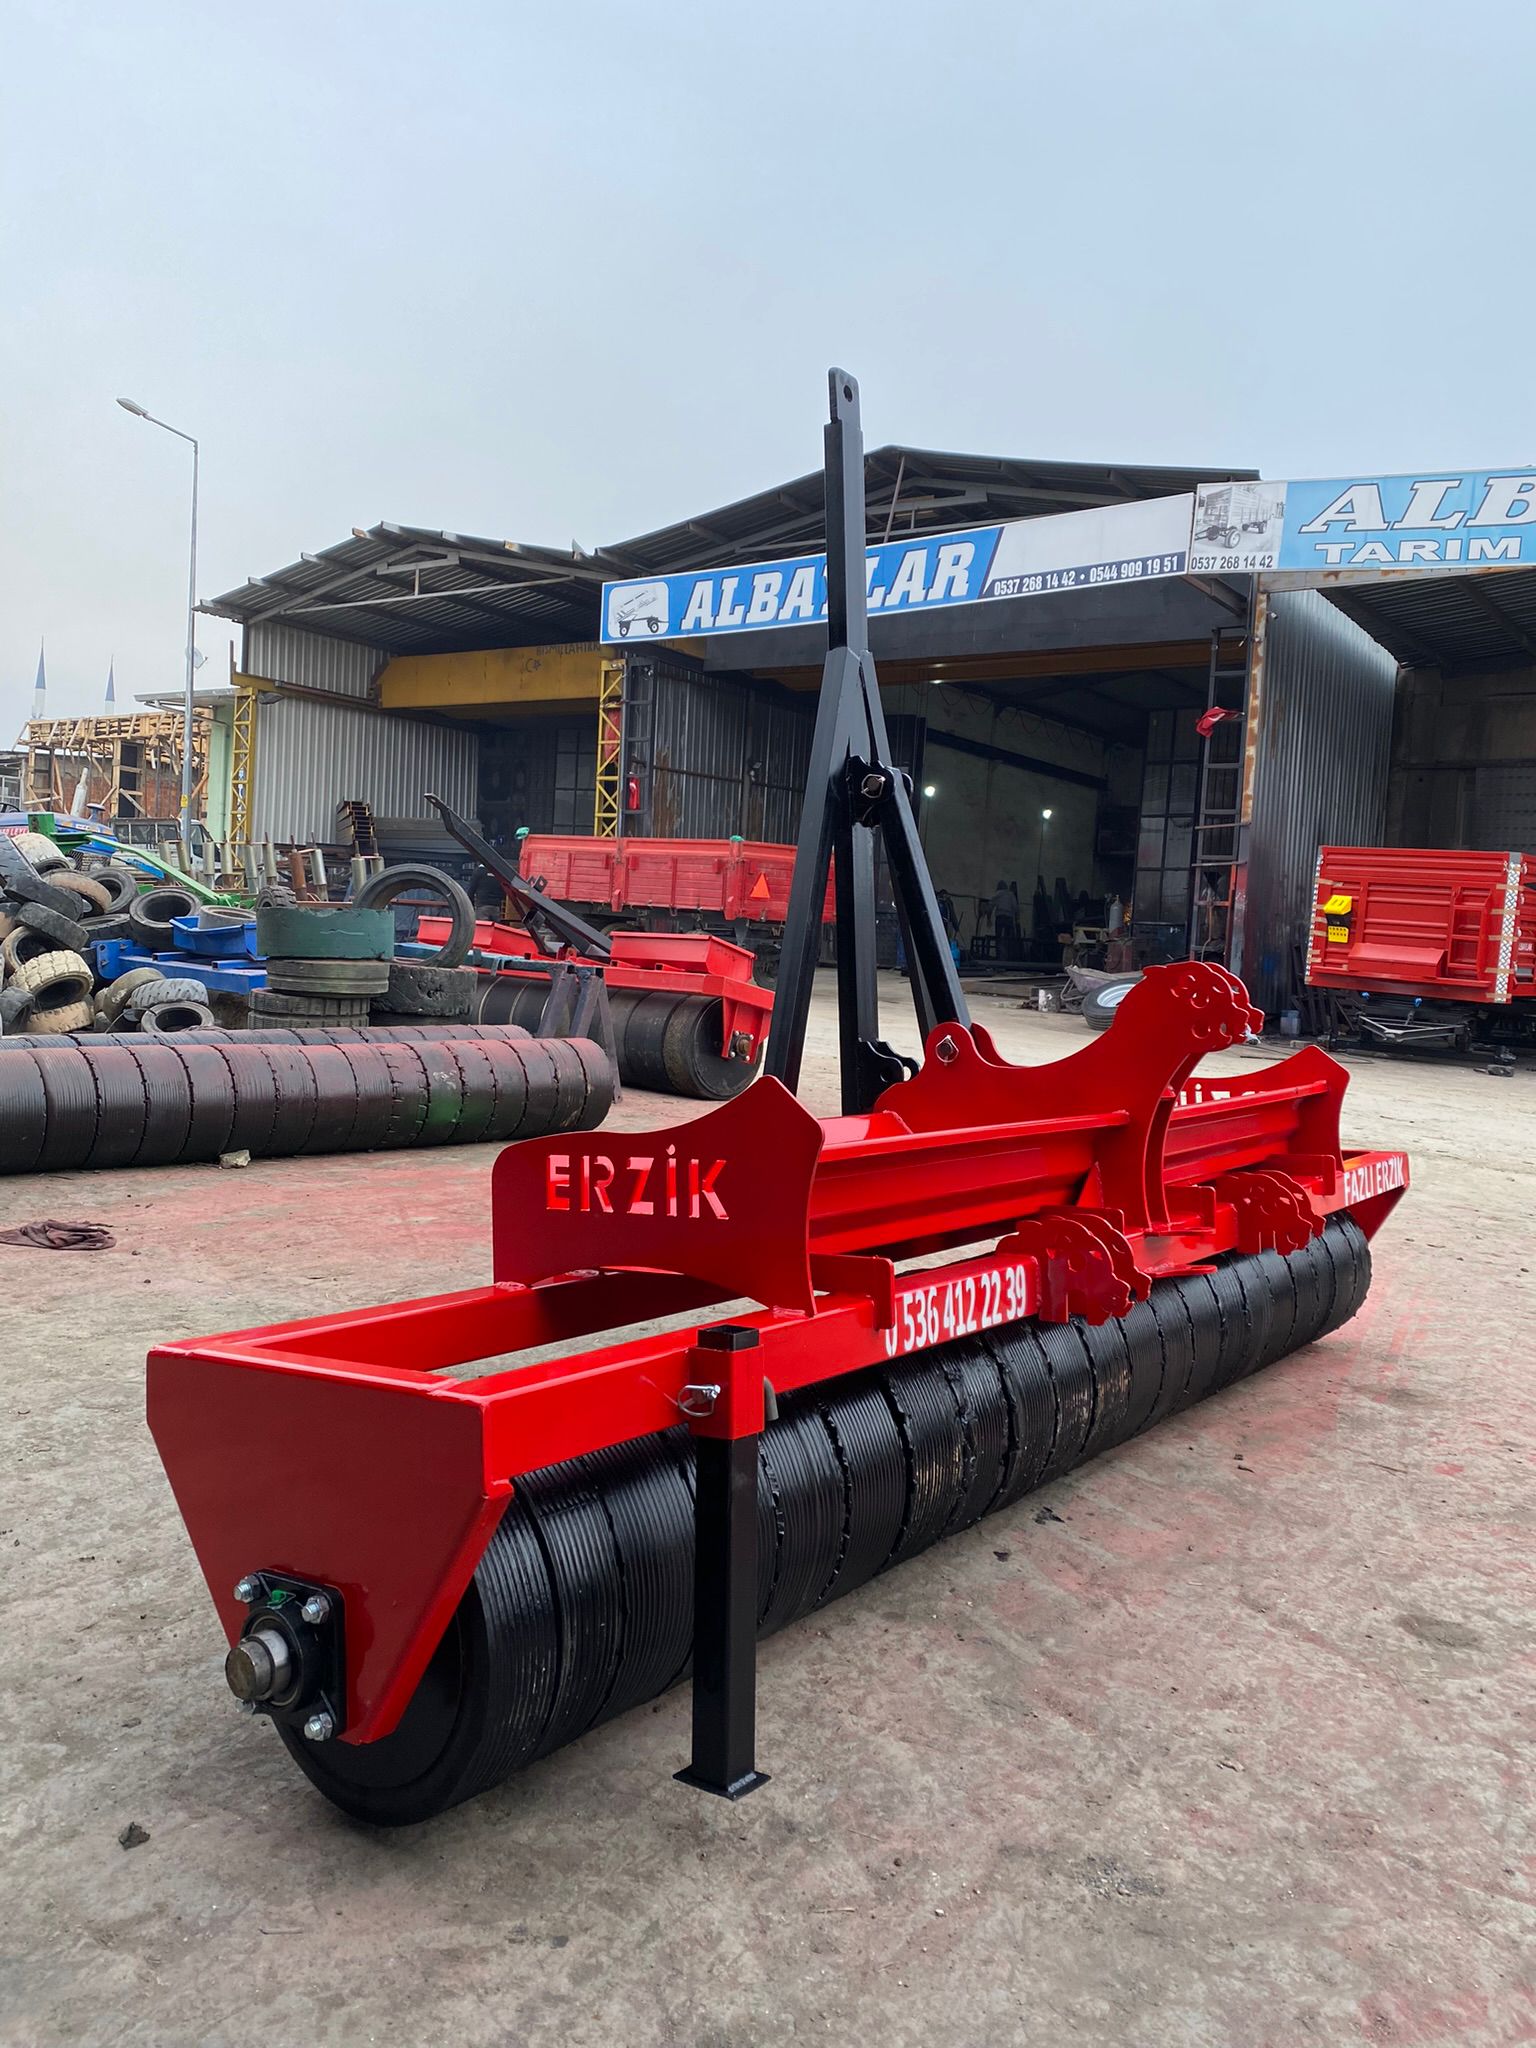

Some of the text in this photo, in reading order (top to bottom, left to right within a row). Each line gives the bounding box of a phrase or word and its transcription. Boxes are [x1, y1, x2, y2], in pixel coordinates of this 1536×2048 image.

[1299, 477, 1536, 534] ALB
[1191, 554, 1273, 570] 0537 268 14 42
[1315, 536, 1522, 564] TARIM
[681, 542, 975, 630] ALBALAR
[994, 555, 1178, 596] 0537 268 14 42 0544 909 19 51
[546, 1144, 730, 1220] ERZİK
[1343, 1164, 1374, 1206] FAZLI
[902, 1286, 939, 1351] 536
[943, 1276, 977, 1337] 412
[981, 1270, 1003, 1328] 22
[1005, 1264, 1027, 1320] 39
